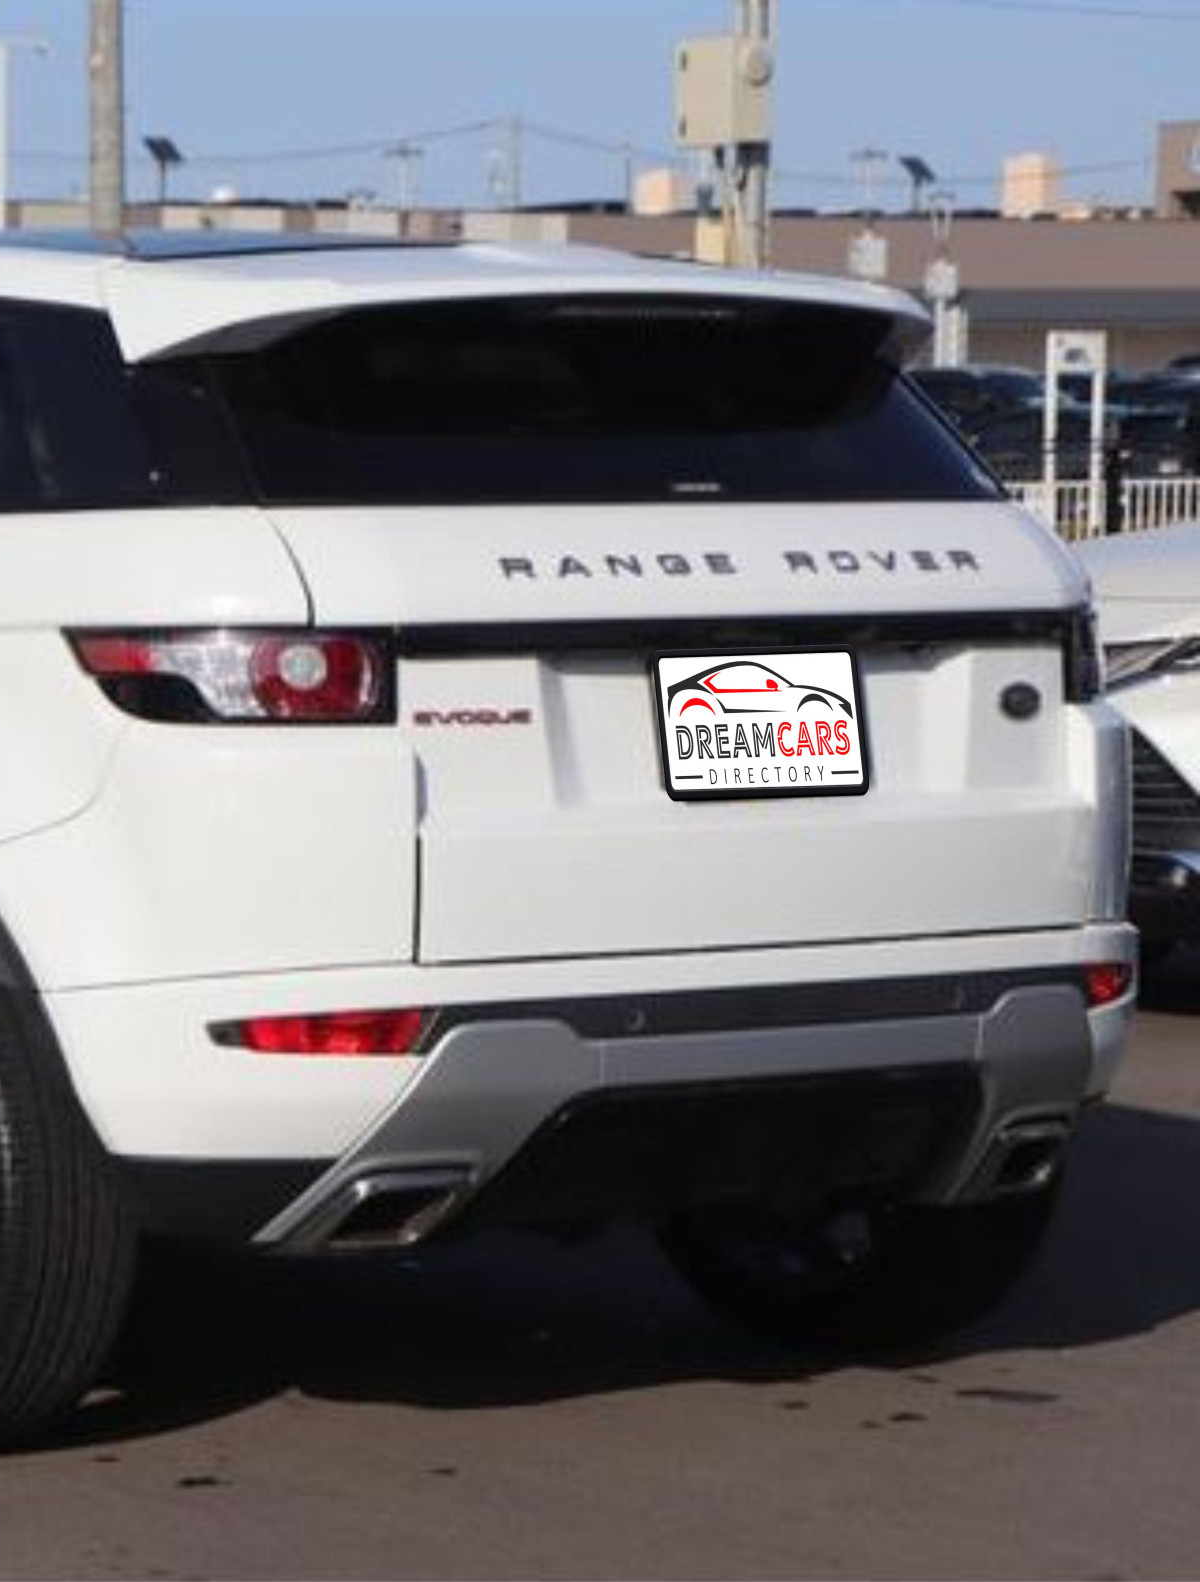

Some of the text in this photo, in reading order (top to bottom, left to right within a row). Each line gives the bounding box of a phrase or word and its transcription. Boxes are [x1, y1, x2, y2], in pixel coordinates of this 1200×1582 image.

[499, 550, 980, 579] RANGE ROVER
[413, 708, 532, 726] EVOQUE
